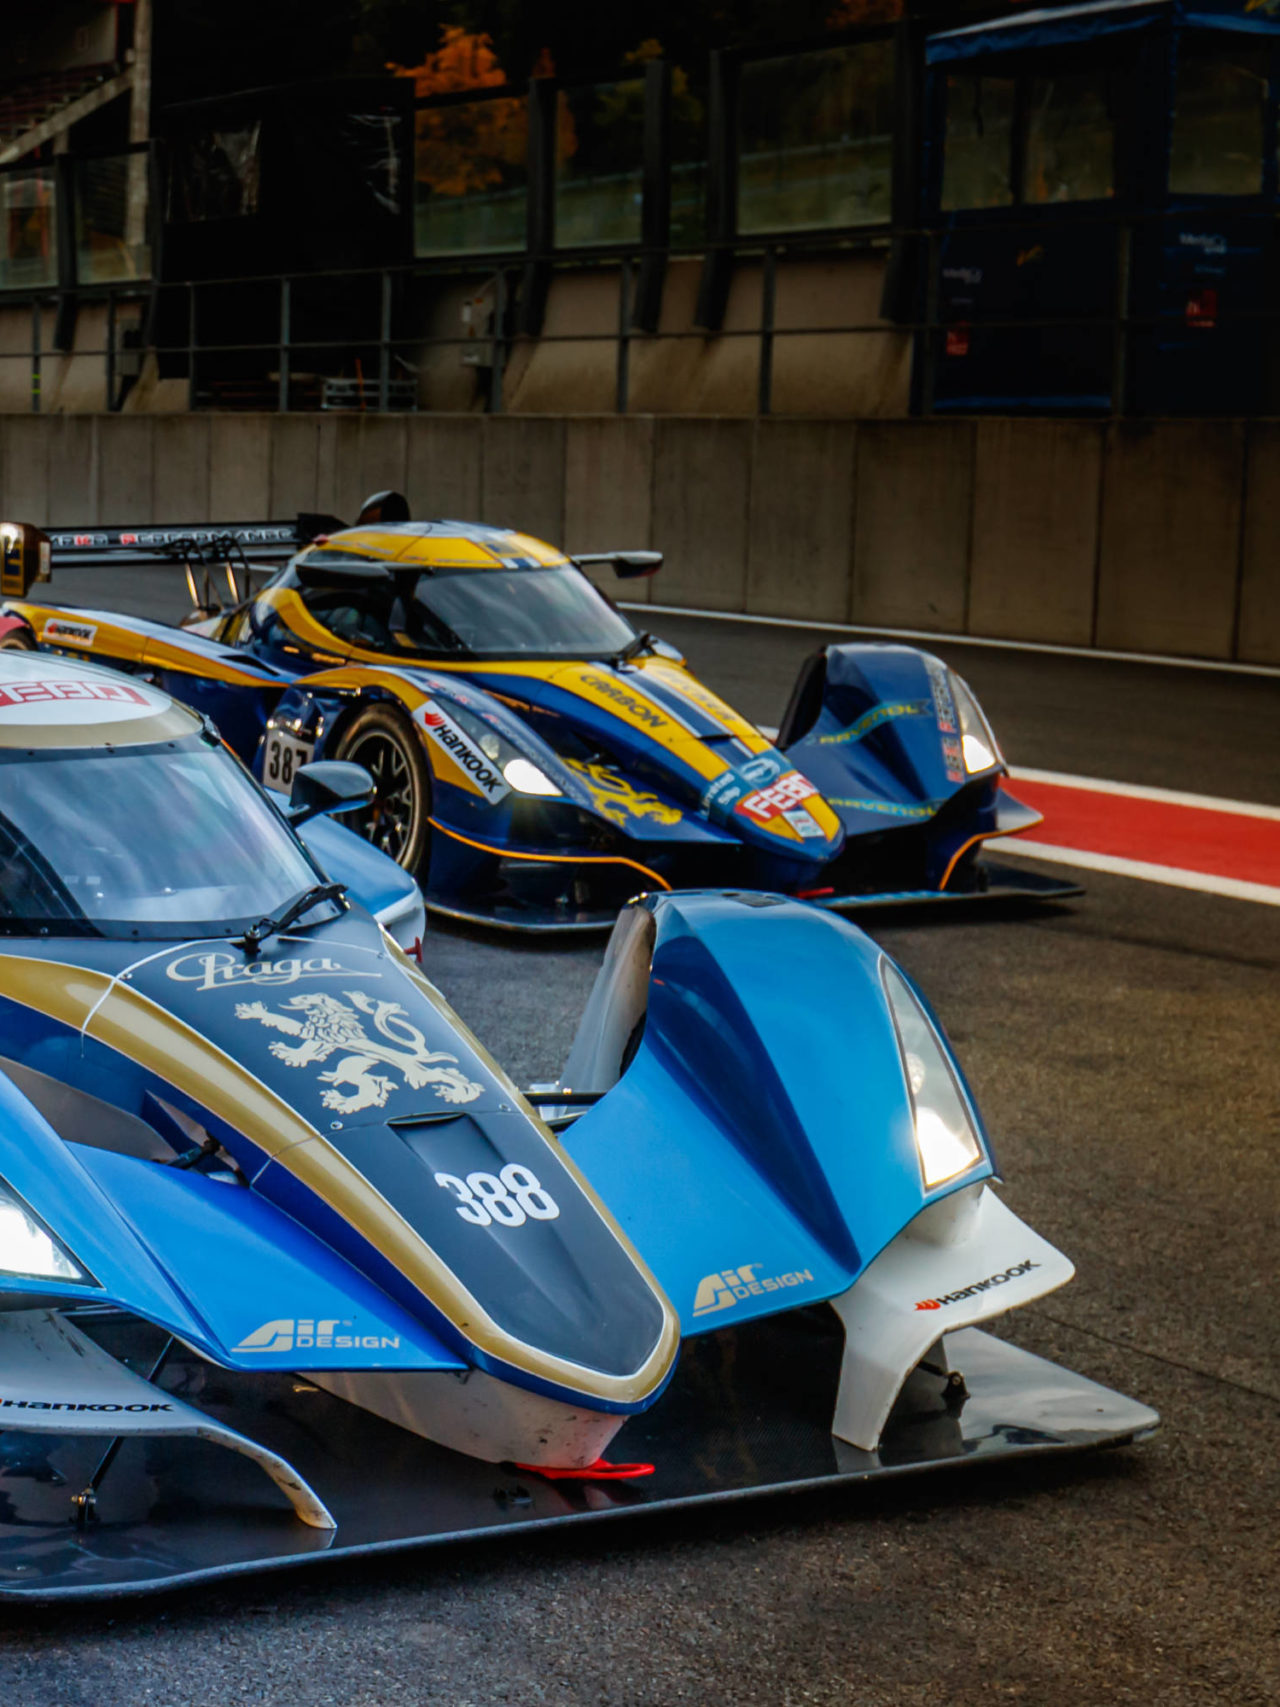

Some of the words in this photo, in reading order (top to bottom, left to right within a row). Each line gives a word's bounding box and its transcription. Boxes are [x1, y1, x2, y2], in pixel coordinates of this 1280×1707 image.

[580, 673, 668, 728] CARBON
[166, 952, 383, 991] Praga
[434, 1163, 561, 1228] 388
[735, 1269, 815, 1299] DESIGN
[296, 1336, 400, 1349] DESIGN
